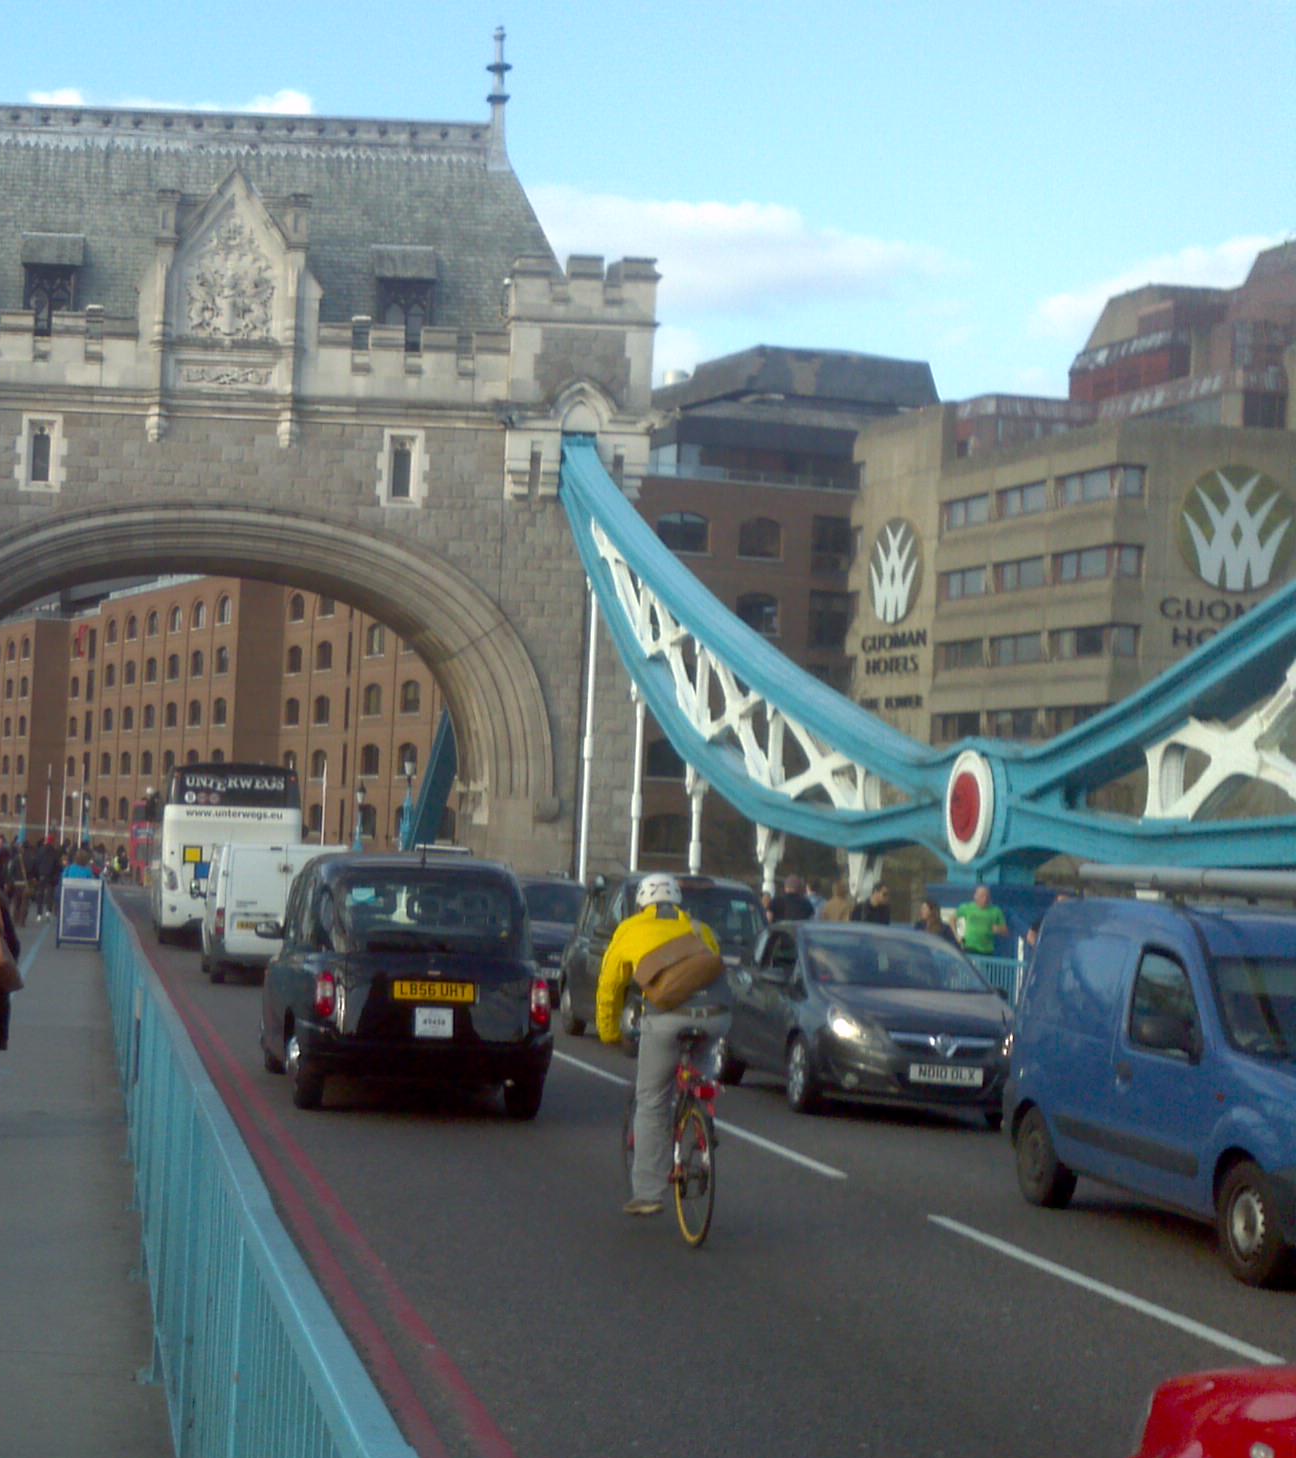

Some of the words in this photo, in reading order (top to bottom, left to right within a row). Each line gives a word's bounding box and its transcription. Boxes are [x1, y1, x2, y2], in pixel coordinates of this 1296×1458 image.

[861, 629, 927, 653] GUOMAN
[865, 654, 919, 675] HOTELS
[185, 775, 285, 791] UNTERWEGS
[186, 808, 283, 820] www.unterwegs.eu
[399, 982, 436, 996] LB56
[440, 983, 467, 997] UHT
